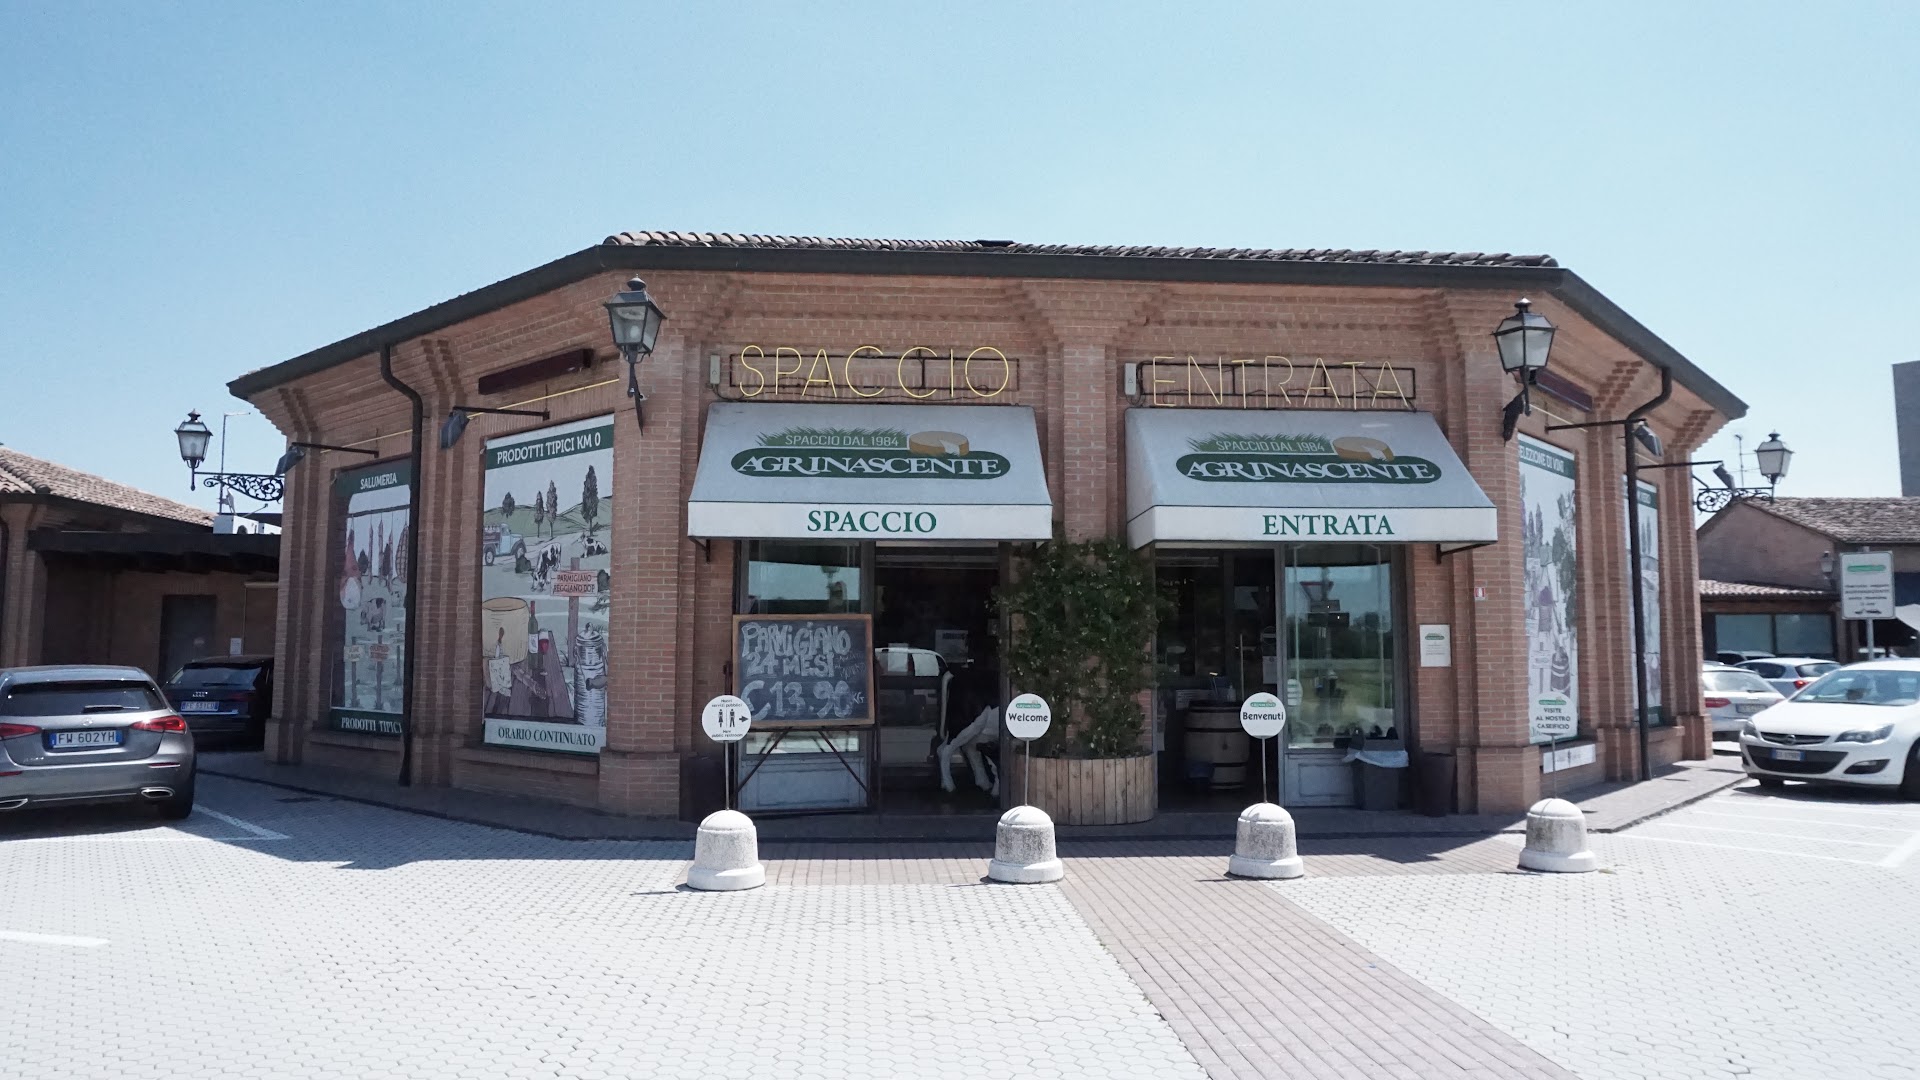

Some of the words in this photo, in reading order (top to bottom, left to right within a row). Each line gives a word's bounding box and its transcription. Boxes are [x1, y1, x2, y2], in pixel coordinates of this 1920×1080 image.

[739, 345, 1009, 398] SPACCIO
[1153, 356, 1409, 409] ENTRATA
[497, 444, 544, 464] PRODOTTI
[546, 437, 575, 456] TIPICI
[577, 434, 592, 449] KM
[594, 432, 601, 446] 0
[785, 434, 840, 446] SPACCIO
[842, 435, 868, 447] DAL
[871, 435, 899, 447] 1984
[1216, 440, 1268, 452] SPACCIO
[1270, 441, 1295, 453] DAL
[1297, 441, 1325, 453] 1984
[1519, 445, 1546, 466] ELEZIONE
[738, 456, 1002, 475] AGRINASCENTE
[1187, 460, 1435, 480] AGRINASCENTE
[360, 472, 398, 490] SALUMERIA
[807, 510, 937, 533] SPACCIO
[1263, 514, 1394, 536] ENTRATA
[557, 574, 592, 582] PARMIGIANO
[746, 652, 778, 678] 24
[341, 717, 377, 731] PRODOTTI
[1008, 712, 1049, 722] Welcome
[1242, 711, 1284, 720] Benvenuti
[58, 733, 73, 744] FW
[78, 732, 115, 743] 602YH
[498, 727, 532, 741] ORARIO
[533, 729, 596, 747] CONTINUATO
